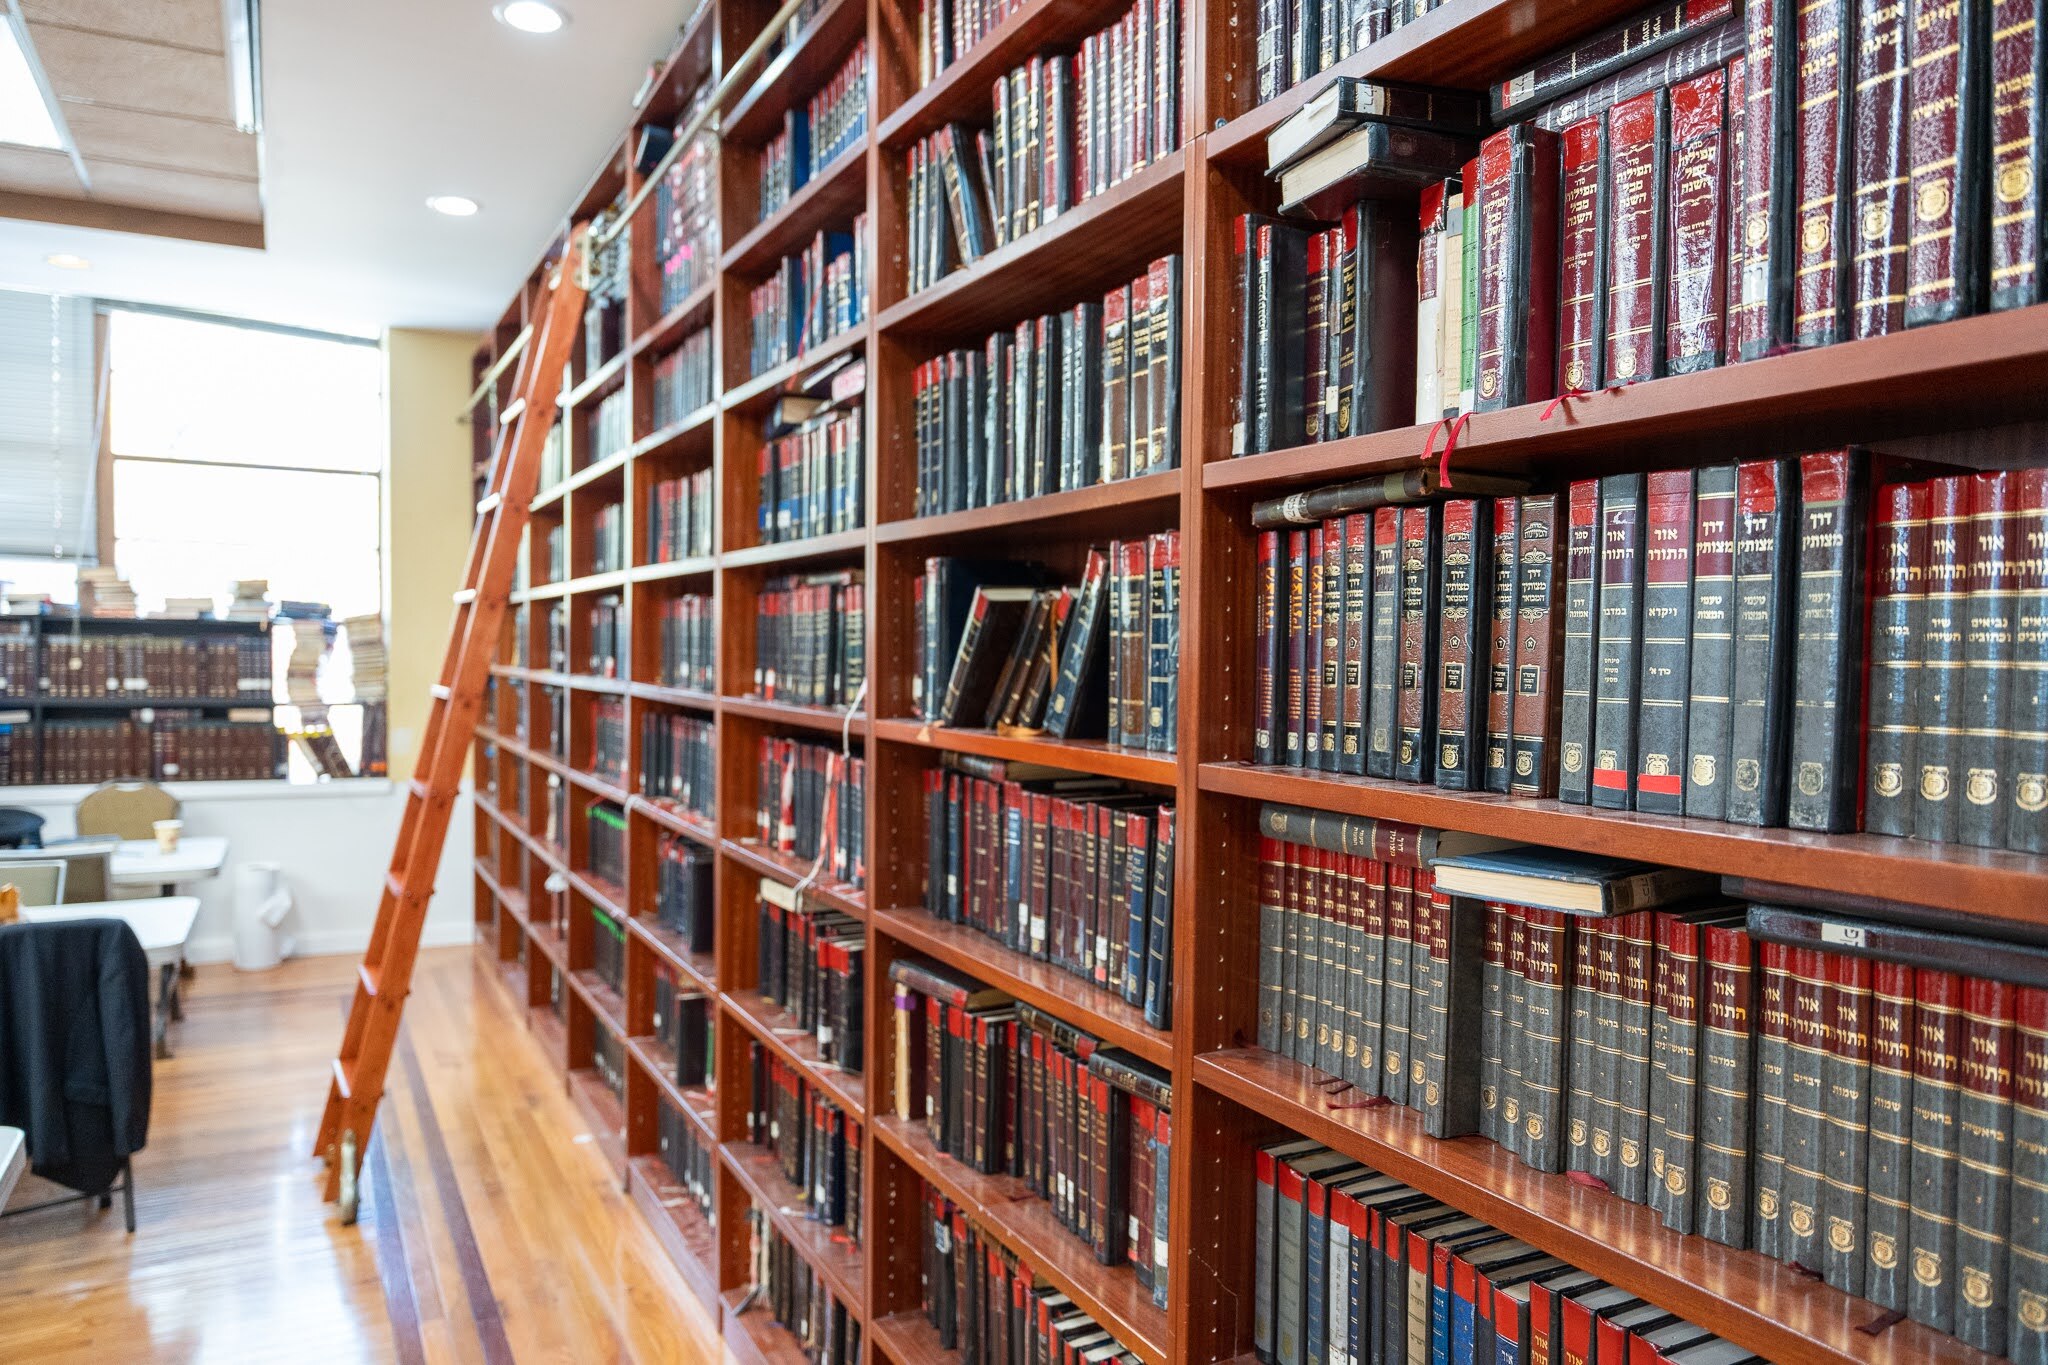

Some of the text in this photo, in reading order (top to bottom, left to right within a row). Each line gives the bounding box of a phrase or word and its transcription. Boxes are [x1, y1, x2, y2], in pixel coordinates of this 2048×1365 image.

[1862, 29, 1902, 56] בינה
[1802, 52, 1837, 78] בינה
[1744, 518, 1767, 535] דרך
[1810, 512, 1832, 529] דרך
[1574, 531, 1588, 540] ספר
[1607, 530, 1626, 541] אור
[1654, 528, 1678, 540] אור
[1703, 521, 1724, 536] דרך
[1696, 540, 1733, 557] מצותיך
[1802, 533, 1844, 551] מצותיך
[1933, 539, 1956, 554] אור
[1979, 535, 2004, 551] אור
[1528, 569, 1541, 578] דרך
[2017, 559, 2048, 576] ורה
[1451, 570, 1466, 580] דרך
[1446, 583, 1469, 592] מצותיך
[1522, 582, 1546, 591] מצותיך
[1573, 599, 1585, 607] דרך
[1700, 595, 1722, 605] טעמי
[1603, 607, 1626, 616] במדבר
[1648, 607, 1678, 619] ויקרא
[1697, 611, 1724, 620] המצות
[1971, 618, 2008, 629] נביאים
[1658, 668, 1671, 676] כרך
[1531, 940, 1549, 954] אור
[1627, 955, 1641, 969] אור
[1598, 968, 1620, 984] התור
[1624, 975, 1648, 991] התור
[1671, 973, 1686, 987] אור
[1713, 981, 1735, 997] אור
[1799, 996, 1819, 1013] אור
[1837, 1005, 1857, 1022] אור
[1878, 1015, 1899, 1032] אור
[1921, 1024, 1944, 1043] אור
[1971, 1037, 1997, 1056] אור
[1793, 1073, 1821, 1087] דברים
[1535, 1335, 1548, 1349] אור
